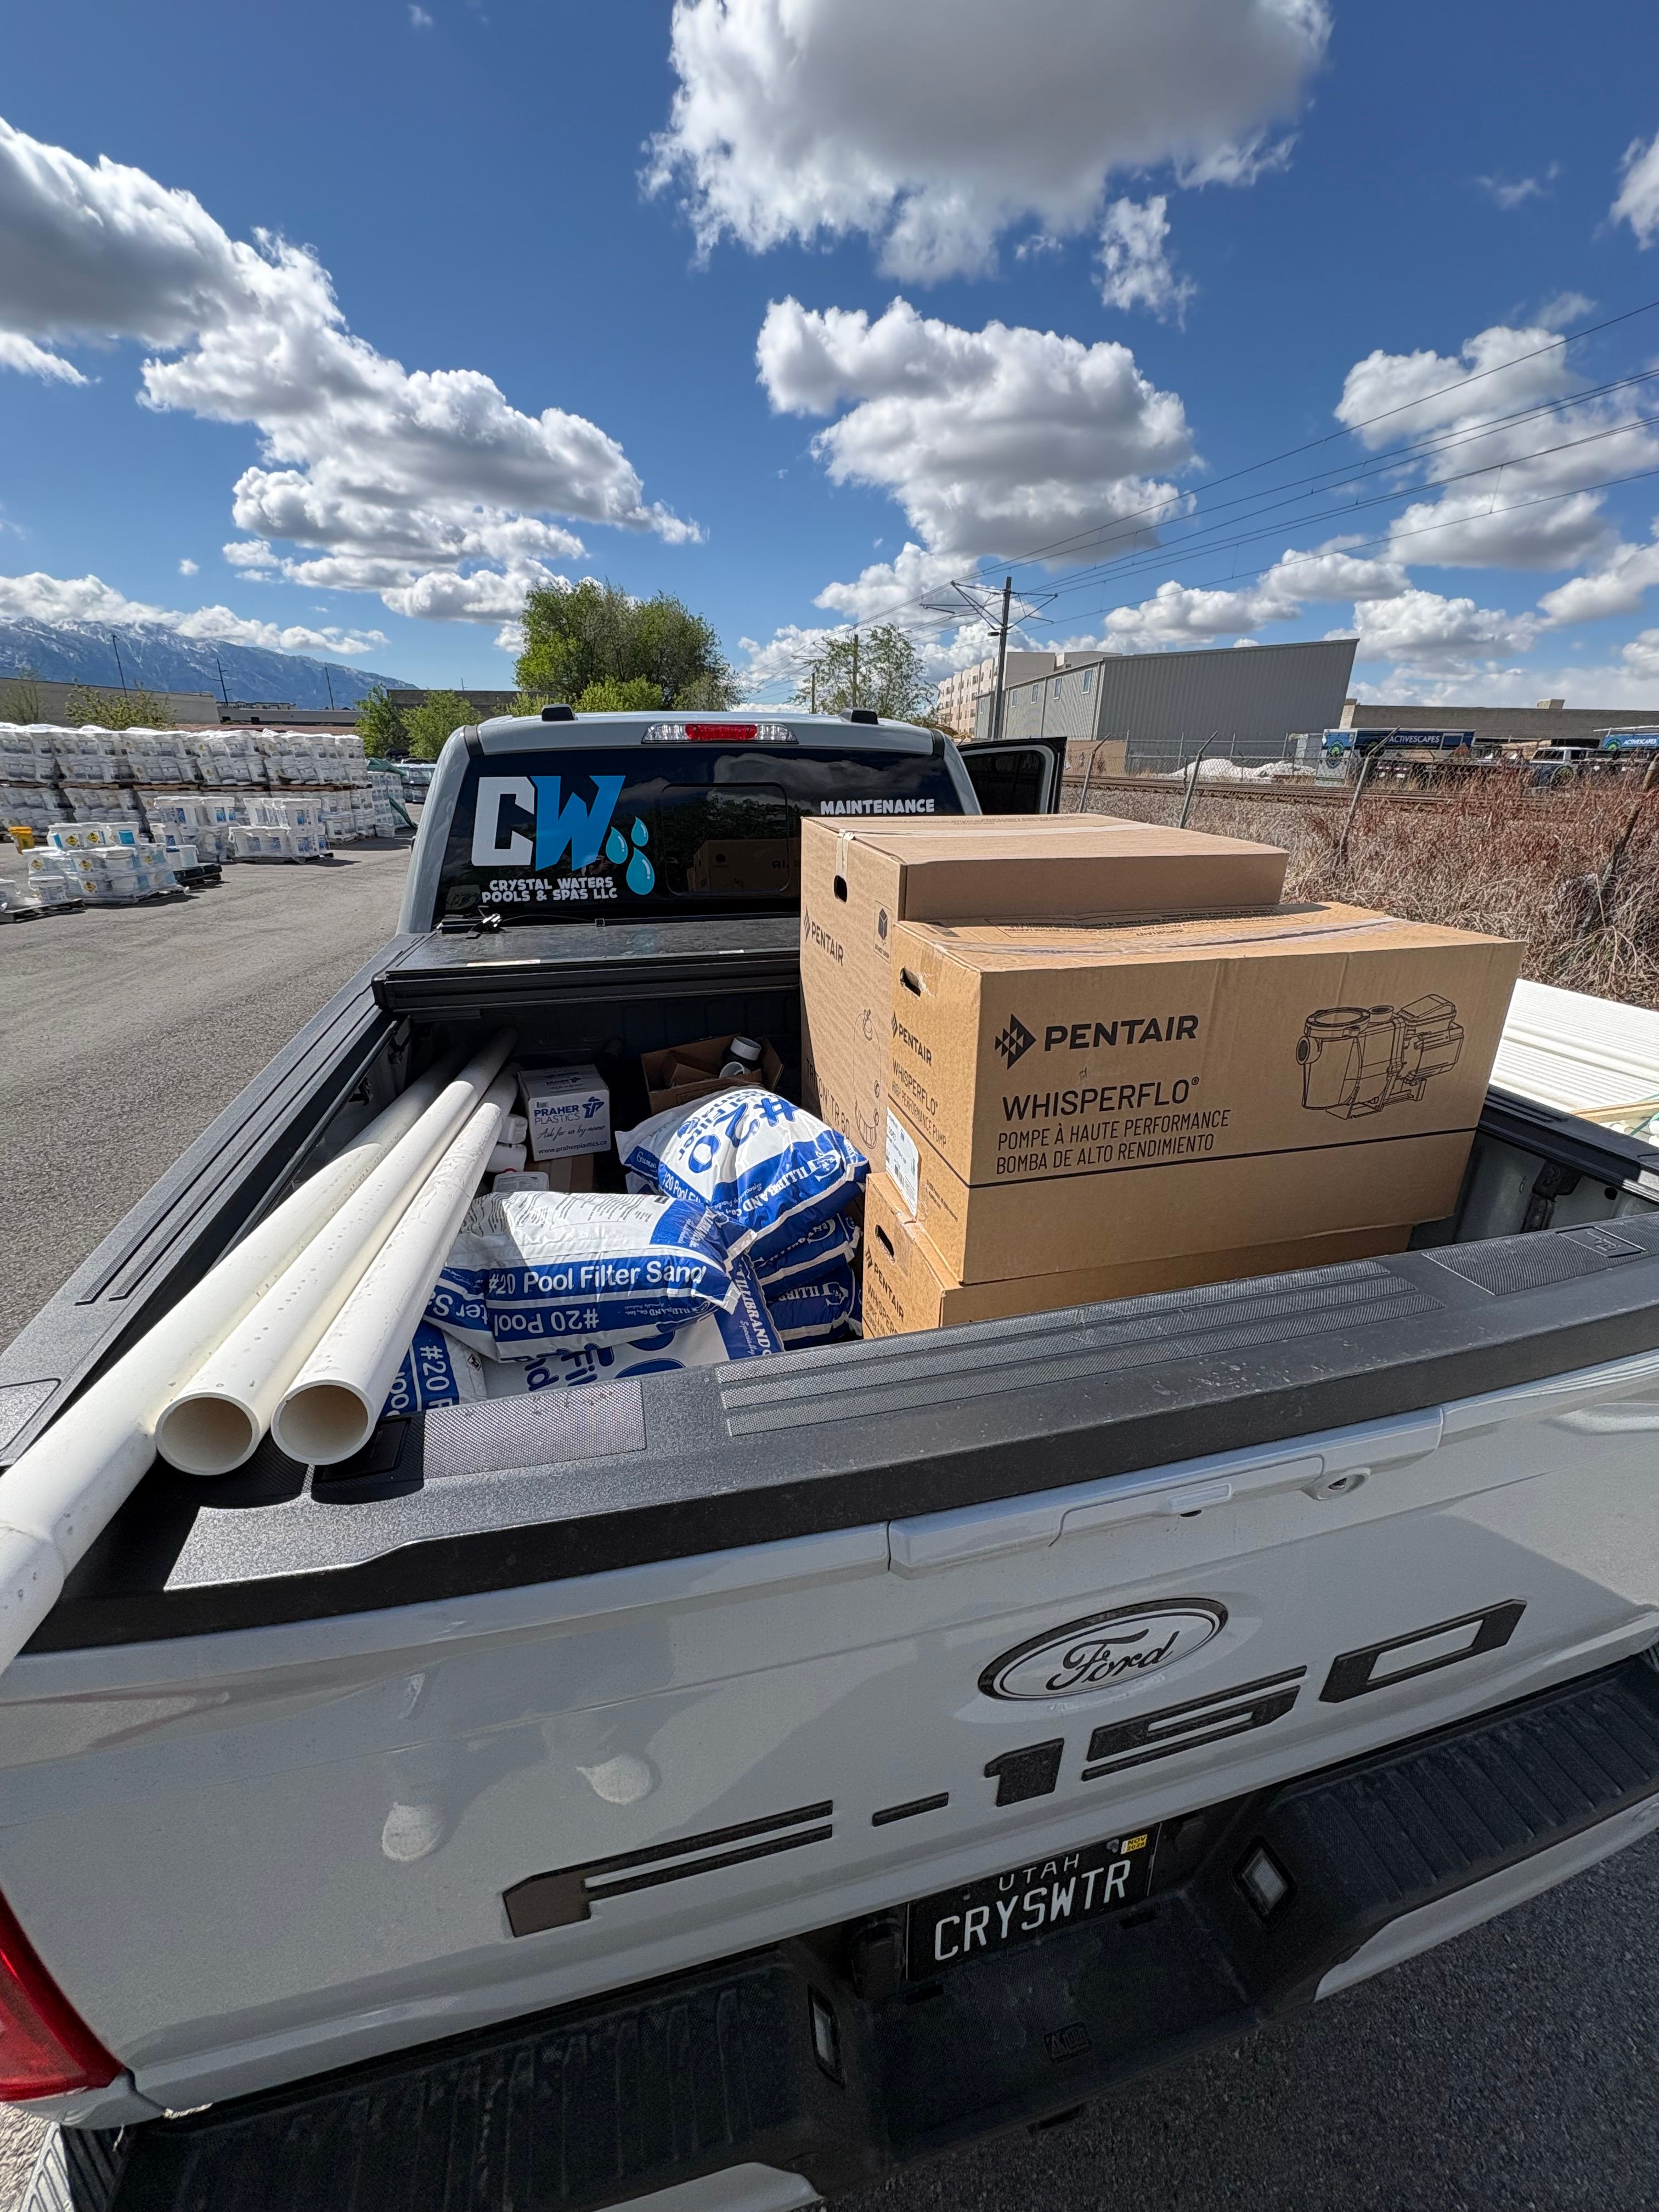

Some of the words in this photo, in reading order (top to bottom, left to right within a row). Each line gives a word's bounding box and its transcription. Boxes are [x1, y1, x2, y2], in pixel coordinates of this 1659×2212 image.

[1389, 735, 1440, 744] ACTIVESCAPES
[471, 775, 626, 871] CW
[820, 798, 935, 815] MAINTENANCE
[482, 890, 531, 903] POOLS
[536, 890, 548, 901] &
[552, 889, 589, 900] SPAS
[593, 888, 618, 899] LLC
[489, 878, 552, 891] CRYSTAL
[557, 877, 613, 889] WATERS
[812, 921, 843, 967] PENTAIR
[899, 1023, 932, 1067] PENTAIR
[1045, 1015, 1199, 1051] PENTAIR
[534, 1105, 579, 1117] PRAHER
[534, 1113, 580, 1125] PLASTICS
[831, 1095, 839, 1126] TR
[842, 1112, 850, 1139] 60
[902, 1090, 931, 1135] PERFORMANCE
[933, 1124, 946, 1149] PUMP
[537, 1127, 554, 1139] Ask
[552, 1126, 566, 1141] for
[577, 1124, 586, 1137] by
[538, 1141, 607, 1154] www.praherplastics.ca
[998, 1127, 1051, 1151] POMPE
[1054, 1122, 1064, 1145] À
[1070, 1121, 1119, 1143] HAUTE
[1124, 1109, 1231, 1137] PERFORMANCE
[997, 1152, 1048, 1175] BOMBA
[1053, 1150, 1071, 1168] DE
[1077, 1145, 1113, 1165] ALTO
[1118, 1133, 1214, 1161] RENDIMIENTO
[743, 1150, 841, 1212] GILLIBRAND
[488, 1273, 516, 1295] #20
[523, 1267, 573, 1294] Pool
[580, 1264, 641, 1289] Filter
[874, 1261, 904, 1323] PENTAIR
[494, 1313, 544, 1337] Pool
[551, 1308, 600, 1330] #20
[740, 1320, 758, 1355] Specialty
[419, 1345, 450, 1391] #20
[1045, 1628, 1181, 1691] Ford
[1127, 1835, 1147, 1846] NOV
[999, 1853, 1080, 1891] UTAH
[934, 1859, 1131, 1961] CRYSWTR
